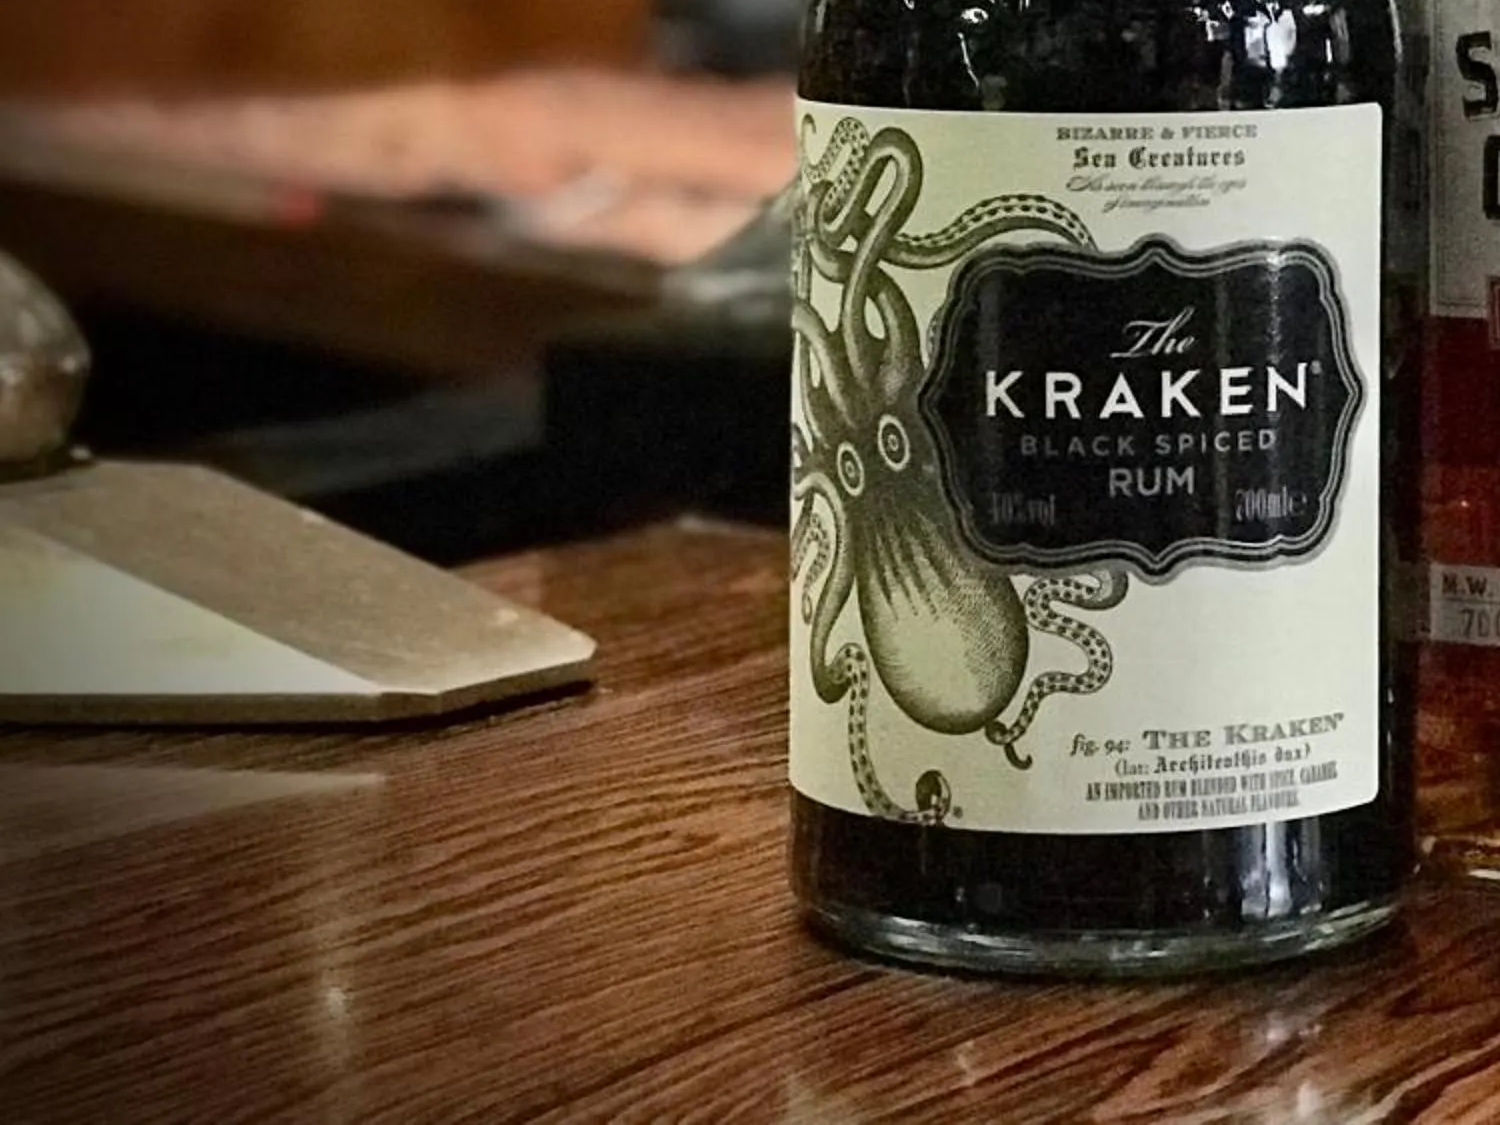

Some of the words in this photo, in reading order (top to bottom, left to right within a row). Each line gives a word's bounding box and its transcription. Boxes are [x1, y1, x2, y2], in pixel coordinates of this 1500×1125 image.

[1056, 126, 1154, 141] BIZARRE
[1073, 146, 1117, 171] Sea
[1128, 145, 1246, 169] Creatures
[1110, 305, 1195, 359] The
[985, 361, 1310, 420] KRAKEN
[1020, 433, 1137, 456] BLACK
[1155, 430, 1278, 456] SPICED
[1107, 465, 1196, 498] RUM
[1141, 729, 1211, 750] THE
[1223, 712, 1345, 746] KRAKEN
